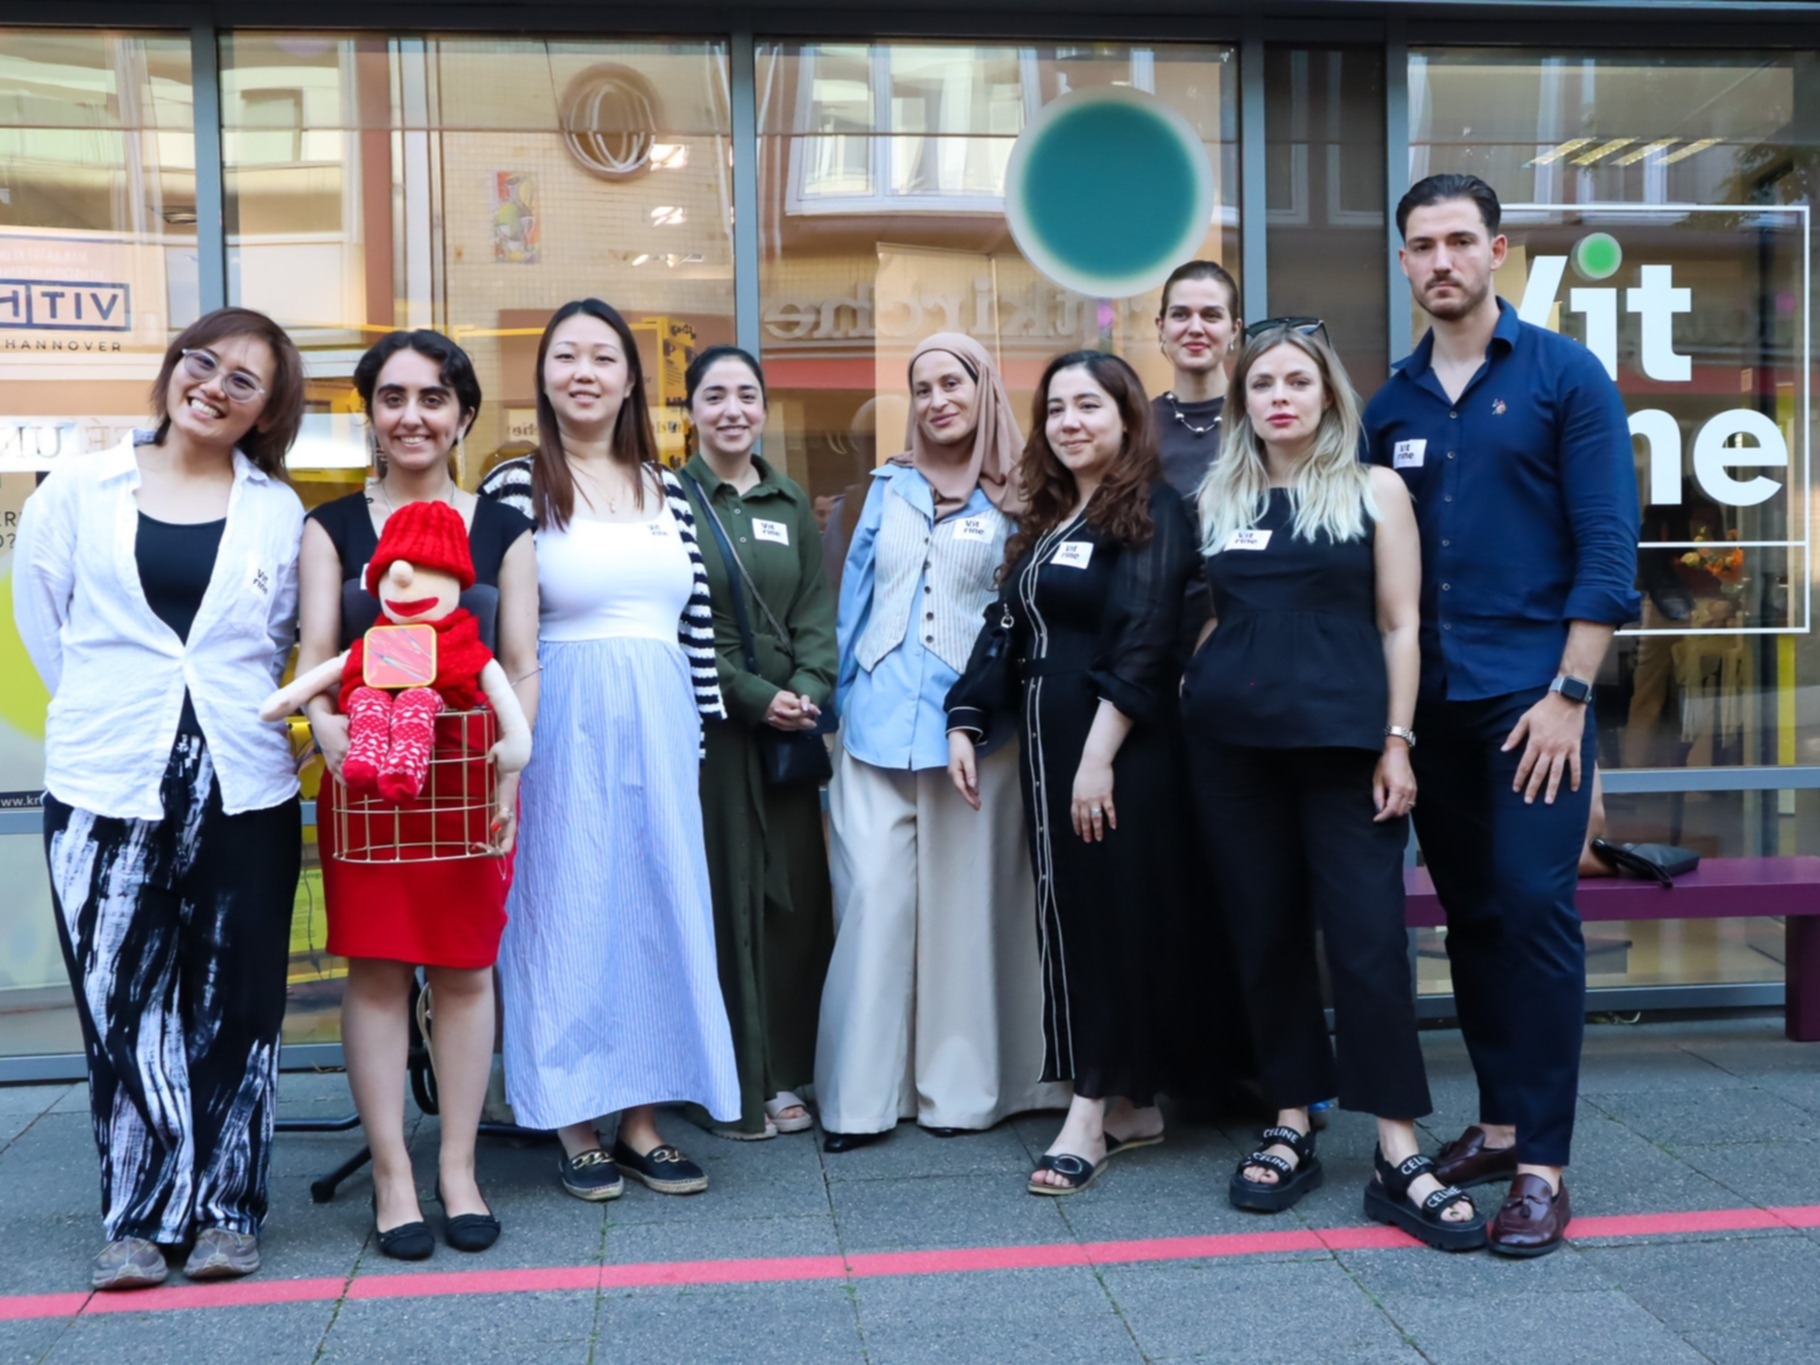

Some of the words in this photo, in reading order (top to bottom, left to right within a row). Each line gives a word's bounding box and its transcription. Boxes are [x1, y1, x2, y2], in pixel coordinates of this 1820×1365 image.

[5, 338, 122, 352] HANNOVER
[1263, 1127, 1299, 1144] CELINE
[1427, 1185, 1462, 1208] CELINE
